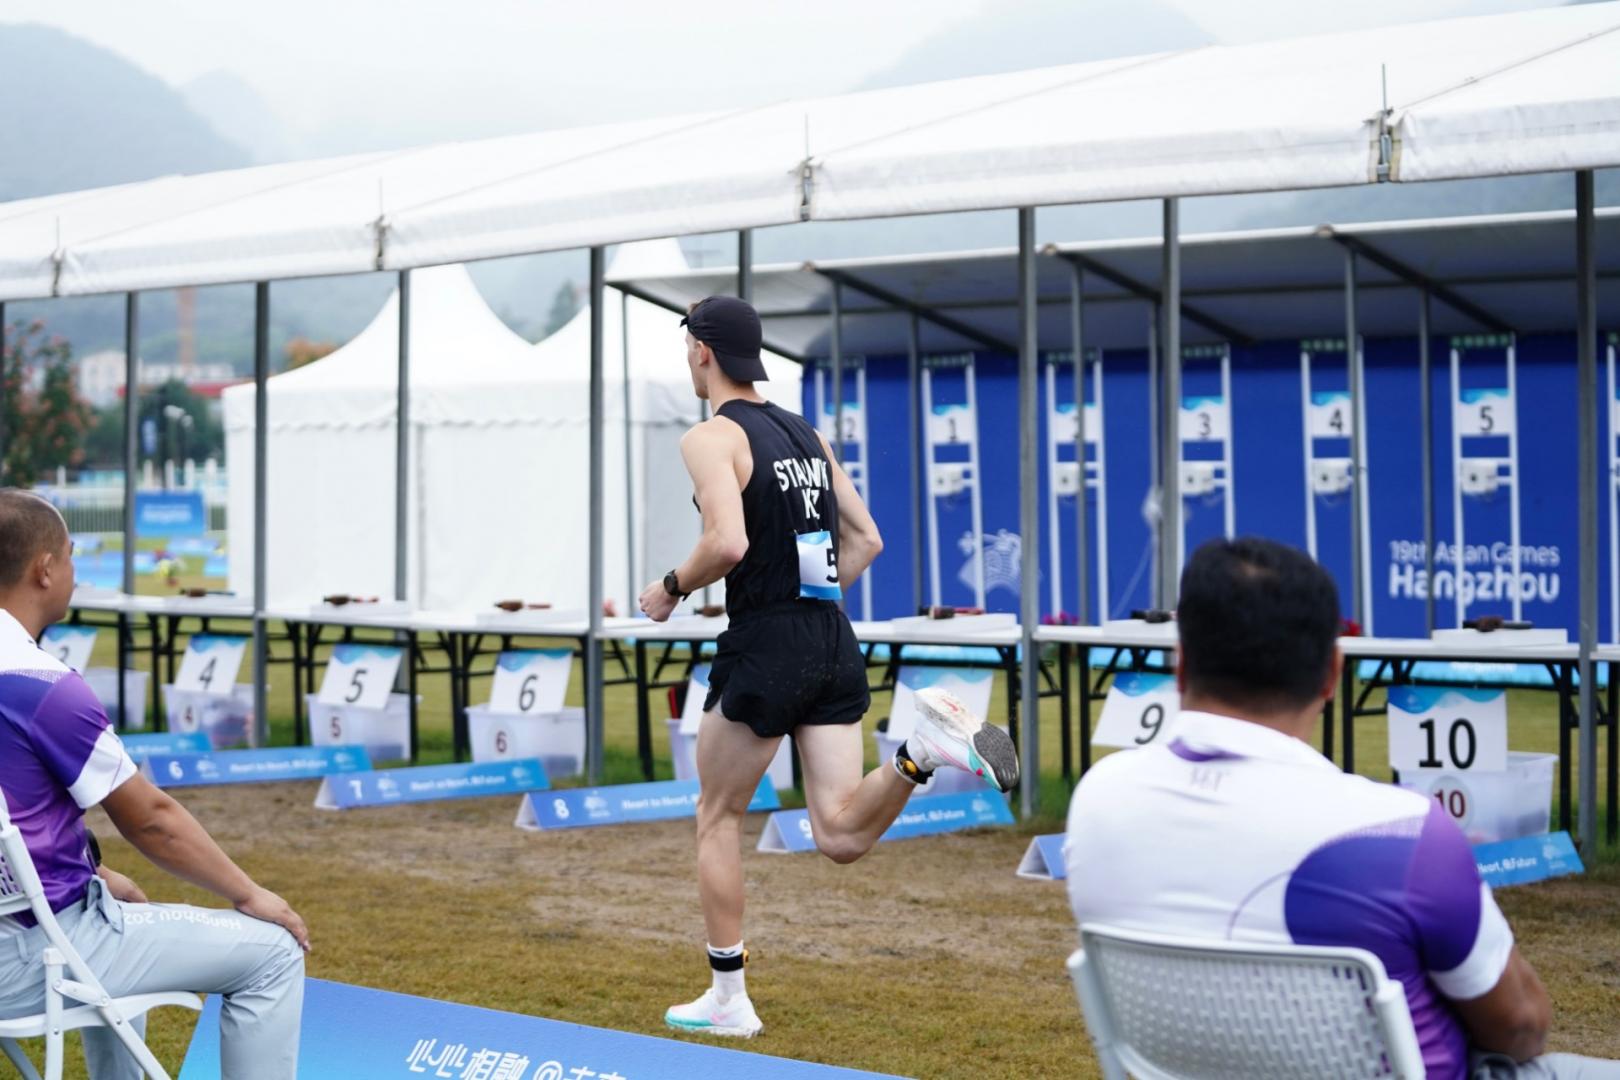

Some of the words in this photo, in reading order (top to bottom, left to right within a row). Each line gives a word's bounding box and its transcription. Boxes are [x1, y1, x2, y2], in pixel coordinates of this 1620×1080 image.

[948, 417, 958, 440] 1
[1198, 412, 1211, 437] 3
[1329, 408, 1343, 433] 4
[1479, 405, 1494, 433] 5
[826, 548, 838, 583] 5
[1434, 541, 1489, 565] Asan
[1389, 563, 1560, 607] Hangzhou
[199, 657, 217, 691] 4
[345, 668, 368, 702] 5
[518, 674, 539, 711] 6
[330, 716, 342, 739] 5
[1134, 702, 1165, 745] 9
[495, 730, 507, 753] 6
[1418, 718, 1477, 769] 10
[168, 760, 184, 780] 6
[349, 780, 363, 799] 7
[553, 798, 570, 819] 8
[124, 911, 155, 925] 202
[160, 911, 241, 929] Hangzhou
